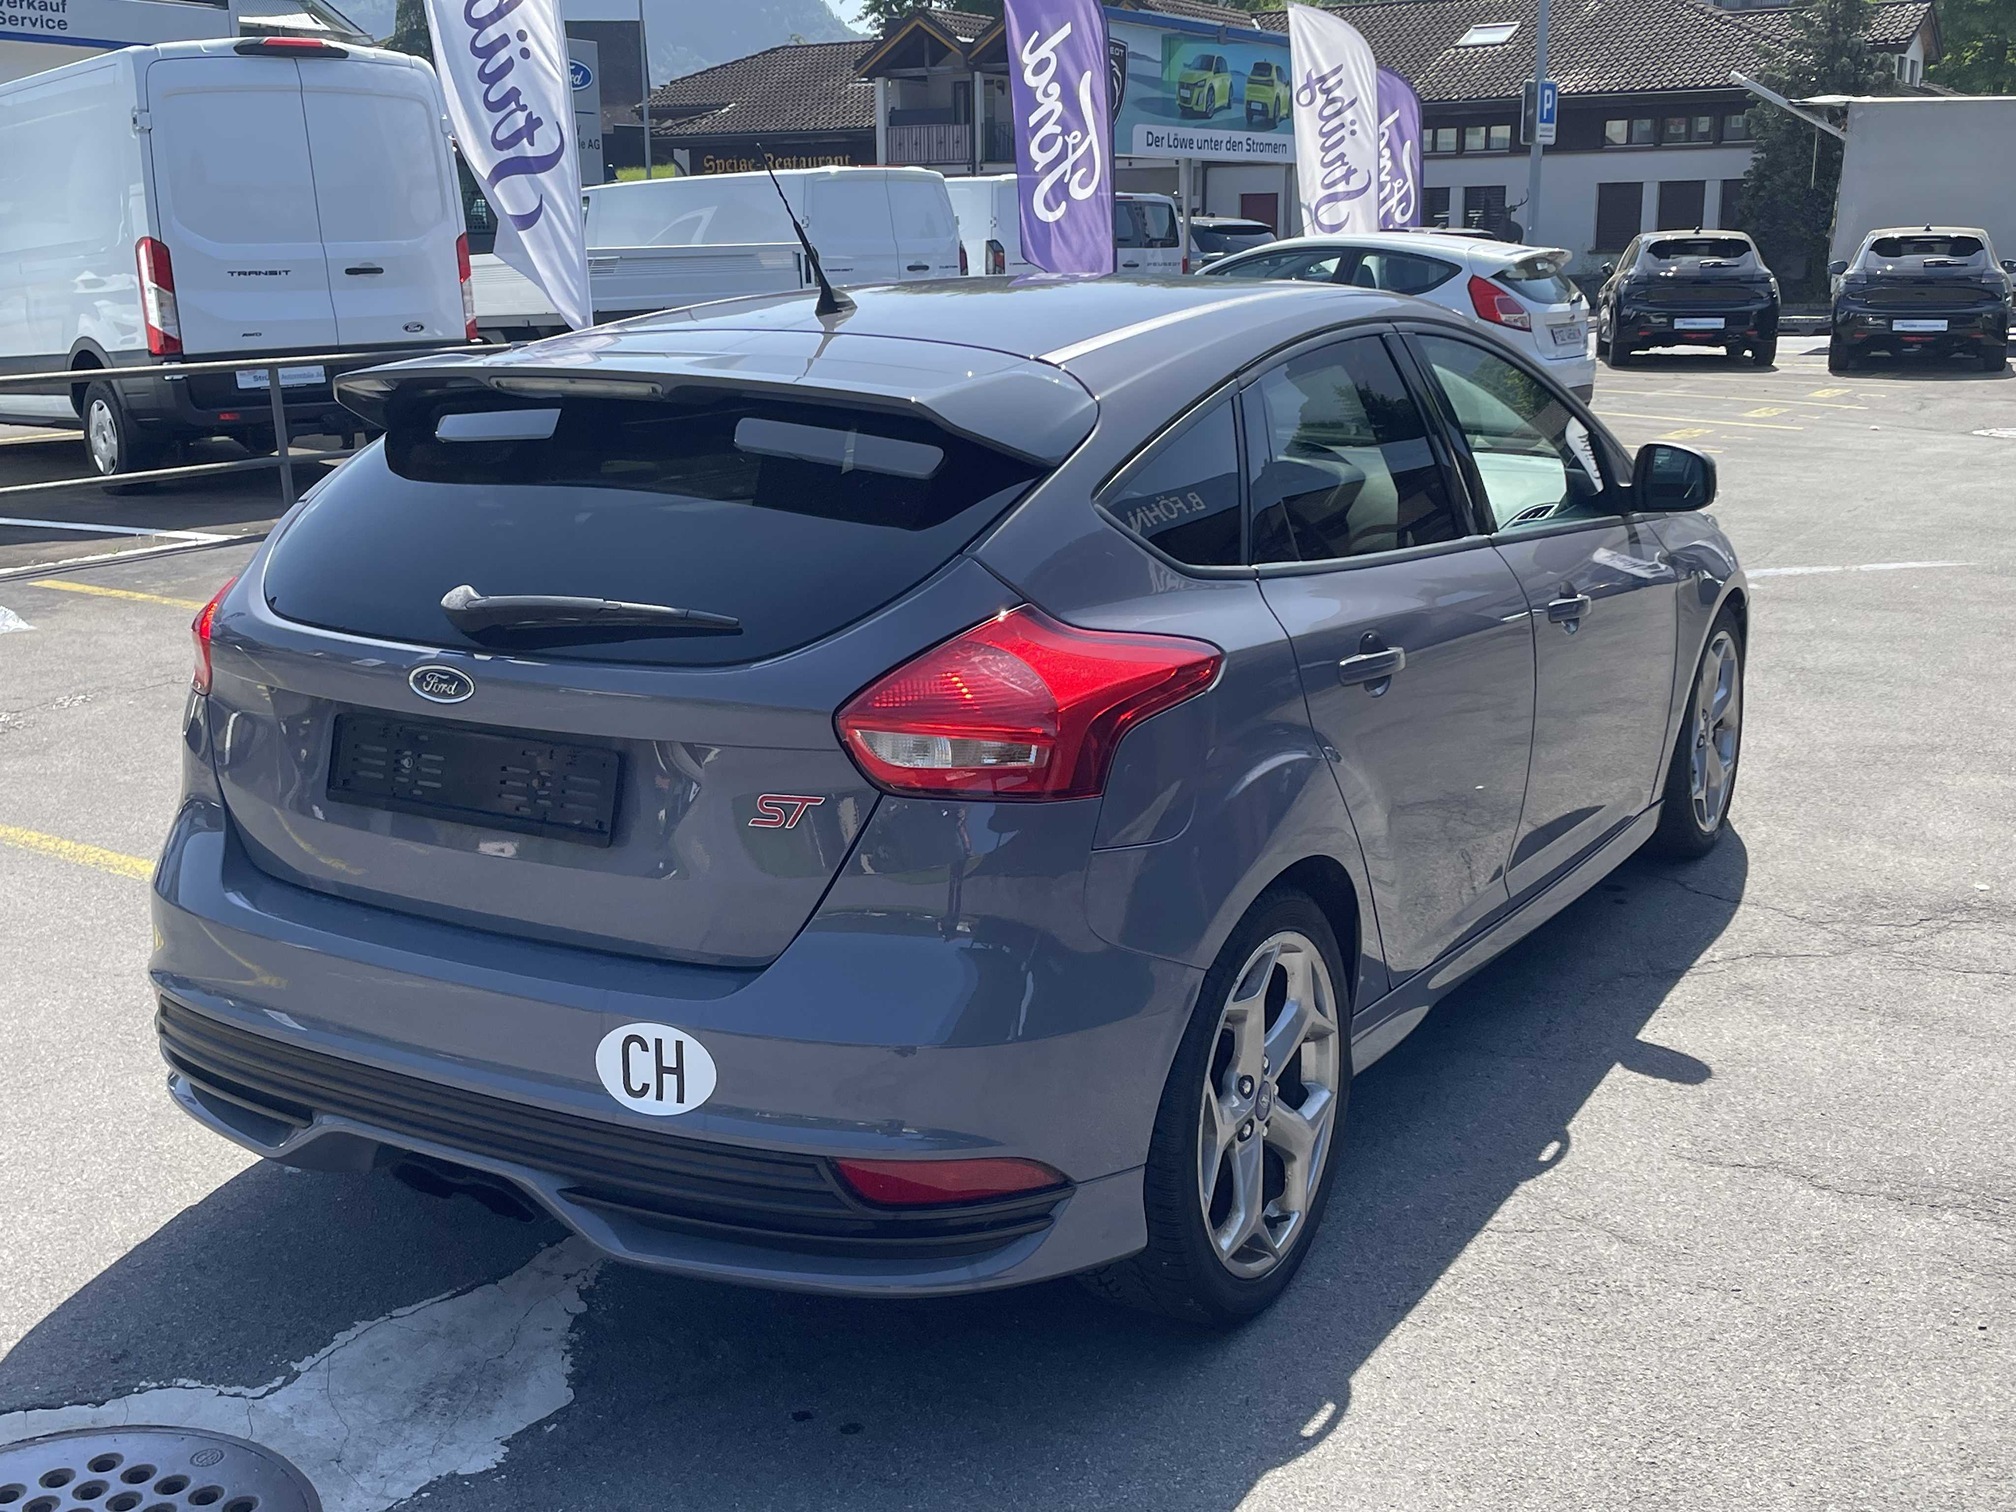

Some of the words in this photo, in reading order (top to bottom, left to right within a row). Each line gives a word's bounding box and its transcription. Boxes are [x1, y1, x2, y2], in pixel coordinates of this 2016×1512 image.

[0, 11, 68, 31] Service
[1543, 89, 1553, 119] P
[588, 139, 600, 150] AG
[1146, 131, 1165, 148] Der
[1167, 133, 1194, 150] Löwe
[1196, 137, 1223, 151] unter
[1225, 137, 1243, 152] den
[1245, 137, 1287, 154] Stromern
[227, 269, 292, 277] TRANSIT
[423, 672, 459, 695] Ford
[748, 794, 826, 829] ST
[622, 1034, 685, 1104] CH
